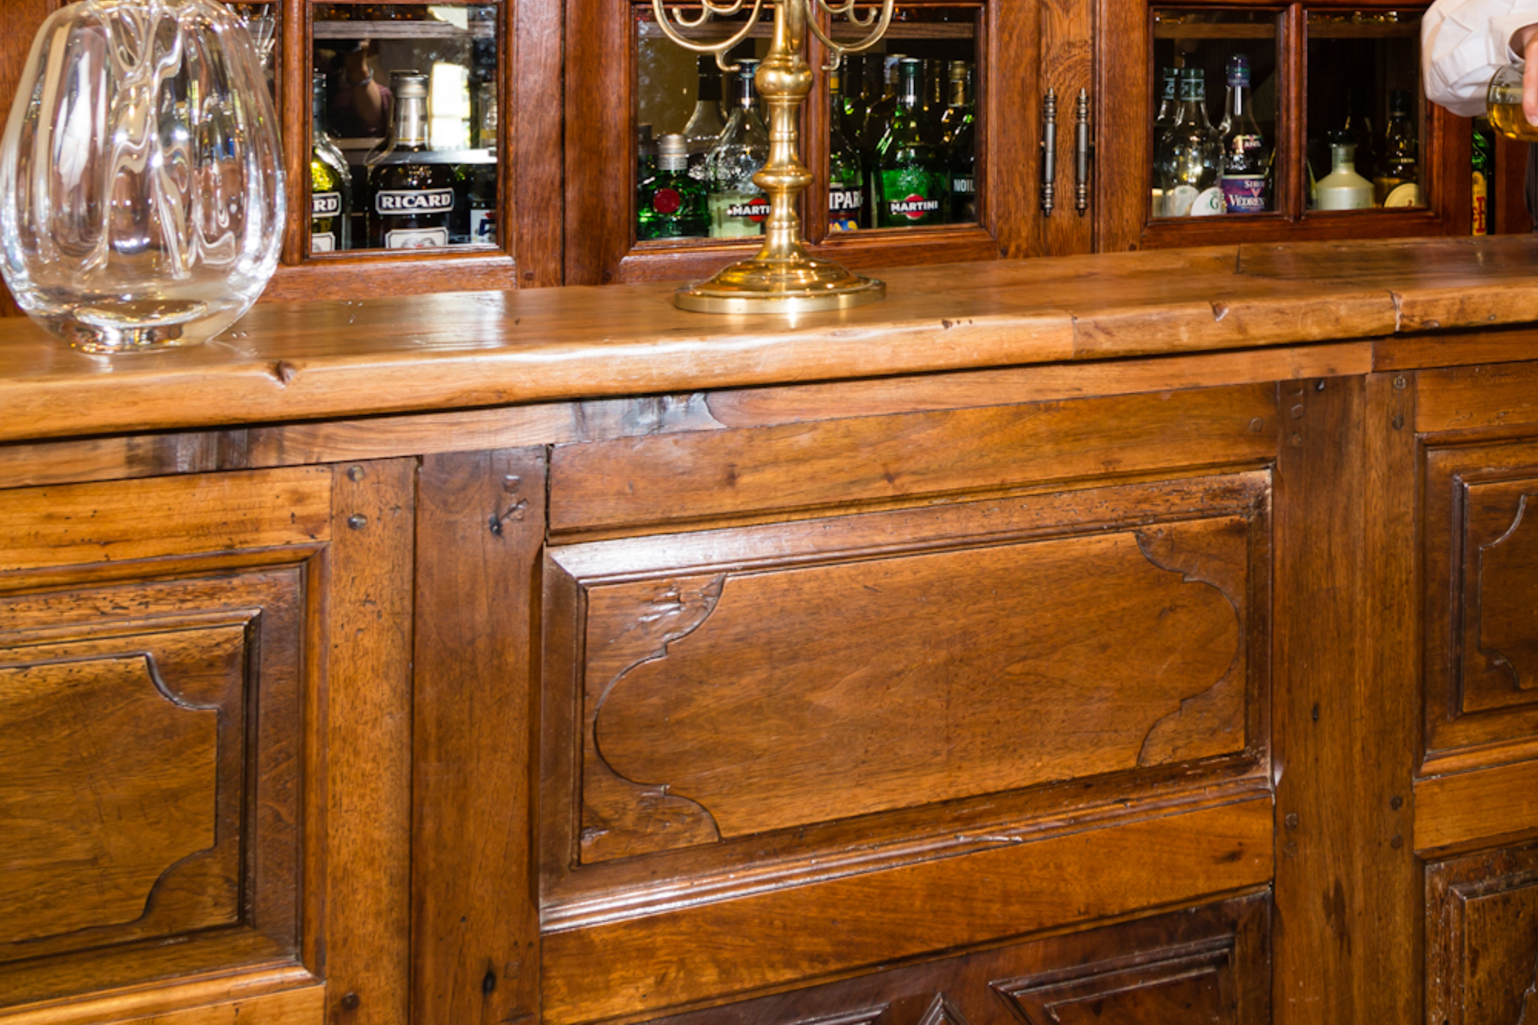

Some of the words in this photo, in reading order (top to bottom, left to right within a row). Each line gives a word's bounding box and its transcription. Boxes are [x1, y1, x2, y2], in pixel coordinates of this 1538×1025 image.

[953, 178, 976, 193] NOIL
[1243, 179, 1265, 189] SIRO
[381, 193, 451, 209] RICARD
[890, 200, 939, 213] MARTINI
[731, 204, 772, 217] MARTI
